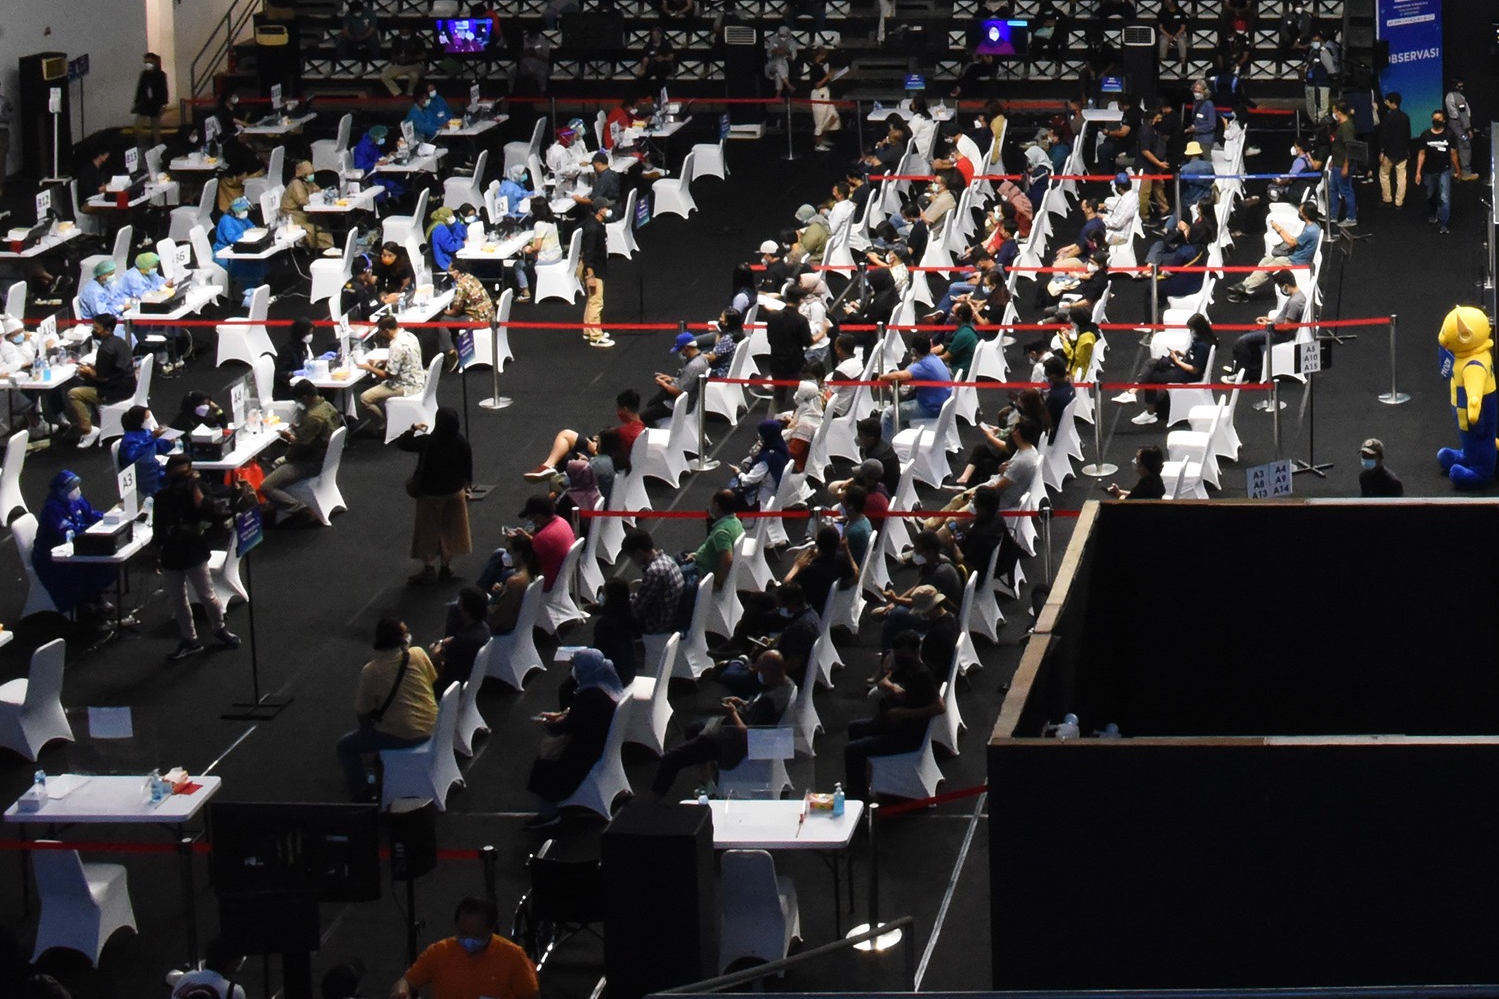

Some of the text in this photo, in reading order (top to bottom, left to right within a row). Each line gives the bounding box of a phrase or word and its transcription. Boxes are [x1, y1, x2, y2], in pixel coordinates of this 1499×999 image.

[1304, 354, 1317, 362] A10
[1304, 362, 1317, 371] A15
[1253, 465, 1287, 480] A3 A4
[123, 472, 133, 489] A3
[1275, 475, 1287, 484] A9
[1252, 485, 1290, 499] A13 A14
